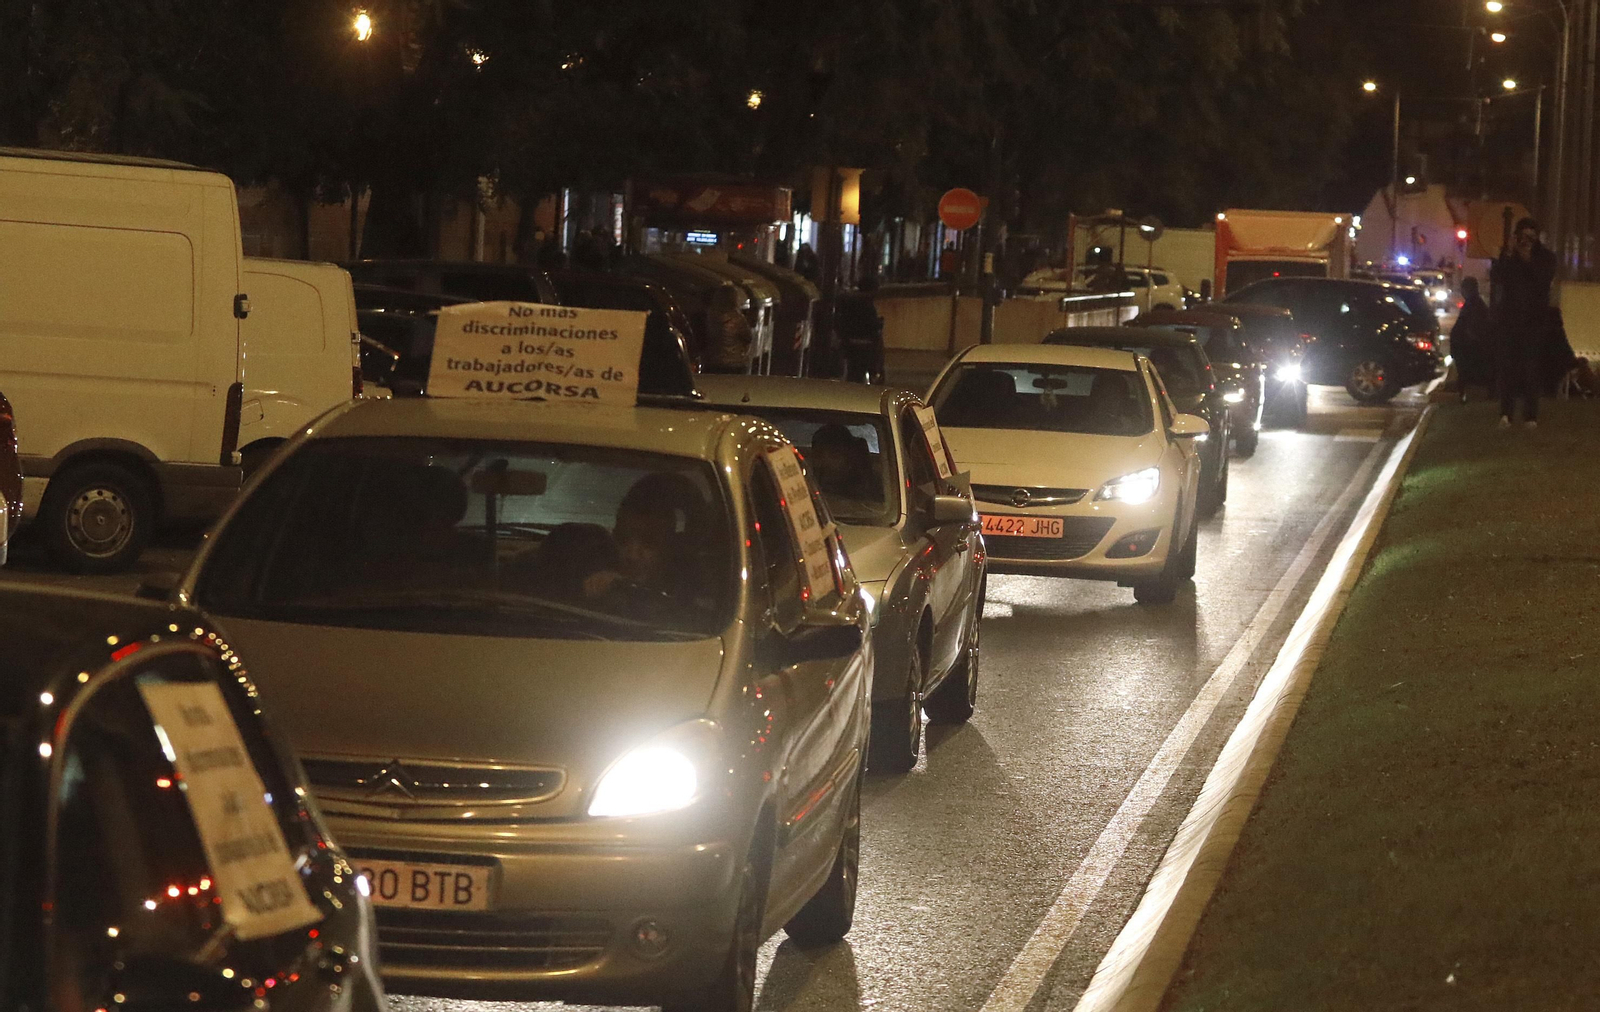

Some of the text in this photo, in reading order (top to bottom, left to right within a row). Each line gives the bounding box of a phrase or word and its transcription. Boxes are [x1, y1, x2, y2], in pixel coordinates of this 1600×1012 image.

[508, 306, 533, 318] No
[462, 319, 618, 341] discriminaciones
[501, 341, 575, 359] a los/as
[447, 357, 624, 382] trabajadores/as de
[464, 379, 600, 399] AUCORSA
[985, 518, 1060, 535] 4422 JHG
[411, 869, 474, 905] BTB
